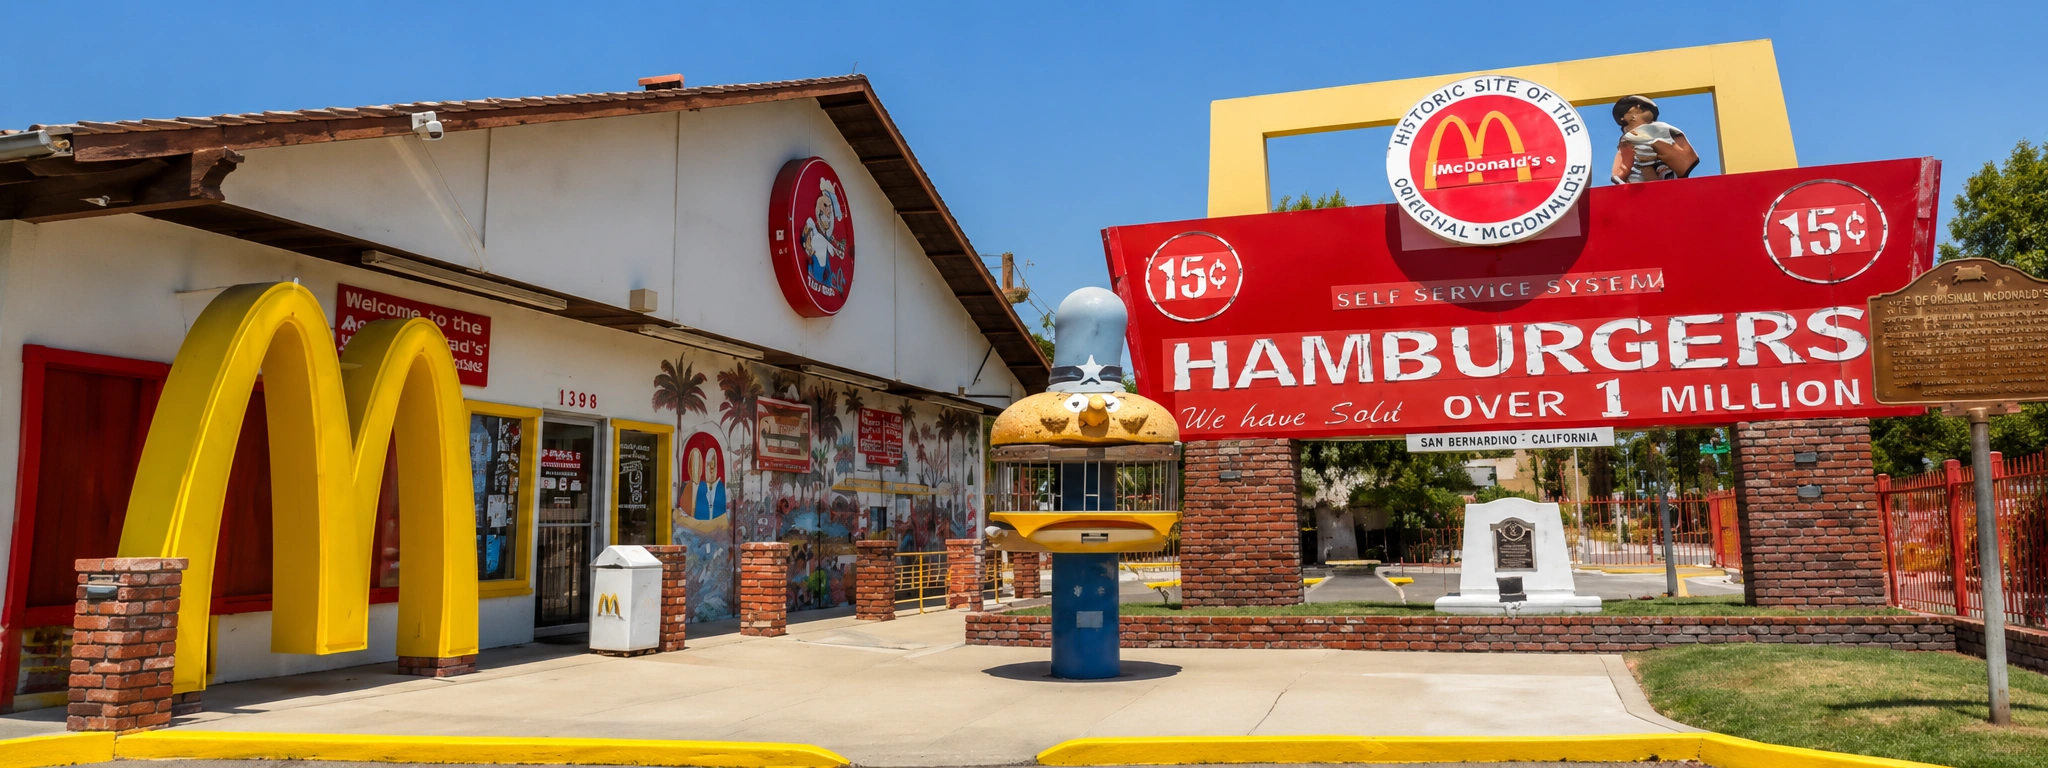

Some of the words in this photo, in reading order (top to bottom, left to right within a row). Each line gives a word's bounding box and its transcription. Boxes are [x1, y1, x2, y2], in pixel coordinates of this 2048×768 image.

[1394, 84, 1465, 146] HISTORIC
[1474, 78, 1520, 93] SITE
[1526, 86, 1552, 103] OF
[1552, 102, 1580, 136] THE
[1778, 207, 1866, 258] 15¢
[1158, 255, 1227, 300] 15¢
[1337, 289, 1400, 307] SELF
[1415, 282, 1531, 302] SERVICE
[345, 290, 422, 319] Welcome
[428, 310, 448, 327] to
[451, 315, 482, 335] the
[1173, 306, 1869, 391] HAMBURGERS
[559, 389, 597, 409] 1398
[1181, 406, 1224, 430] We
[1240, 403, 1306, 428] have
[1443, 391, 1567, 419] OVER
[1595, 378, 1629, 418] 1
[1661, 378, 1861, 413] MILLION
[1420, 437, 1443, 448] SAN
[1448, 435, 1518, 447] BERNARDINO
[1531, 432, 1599, 445] CALIFORNIA
